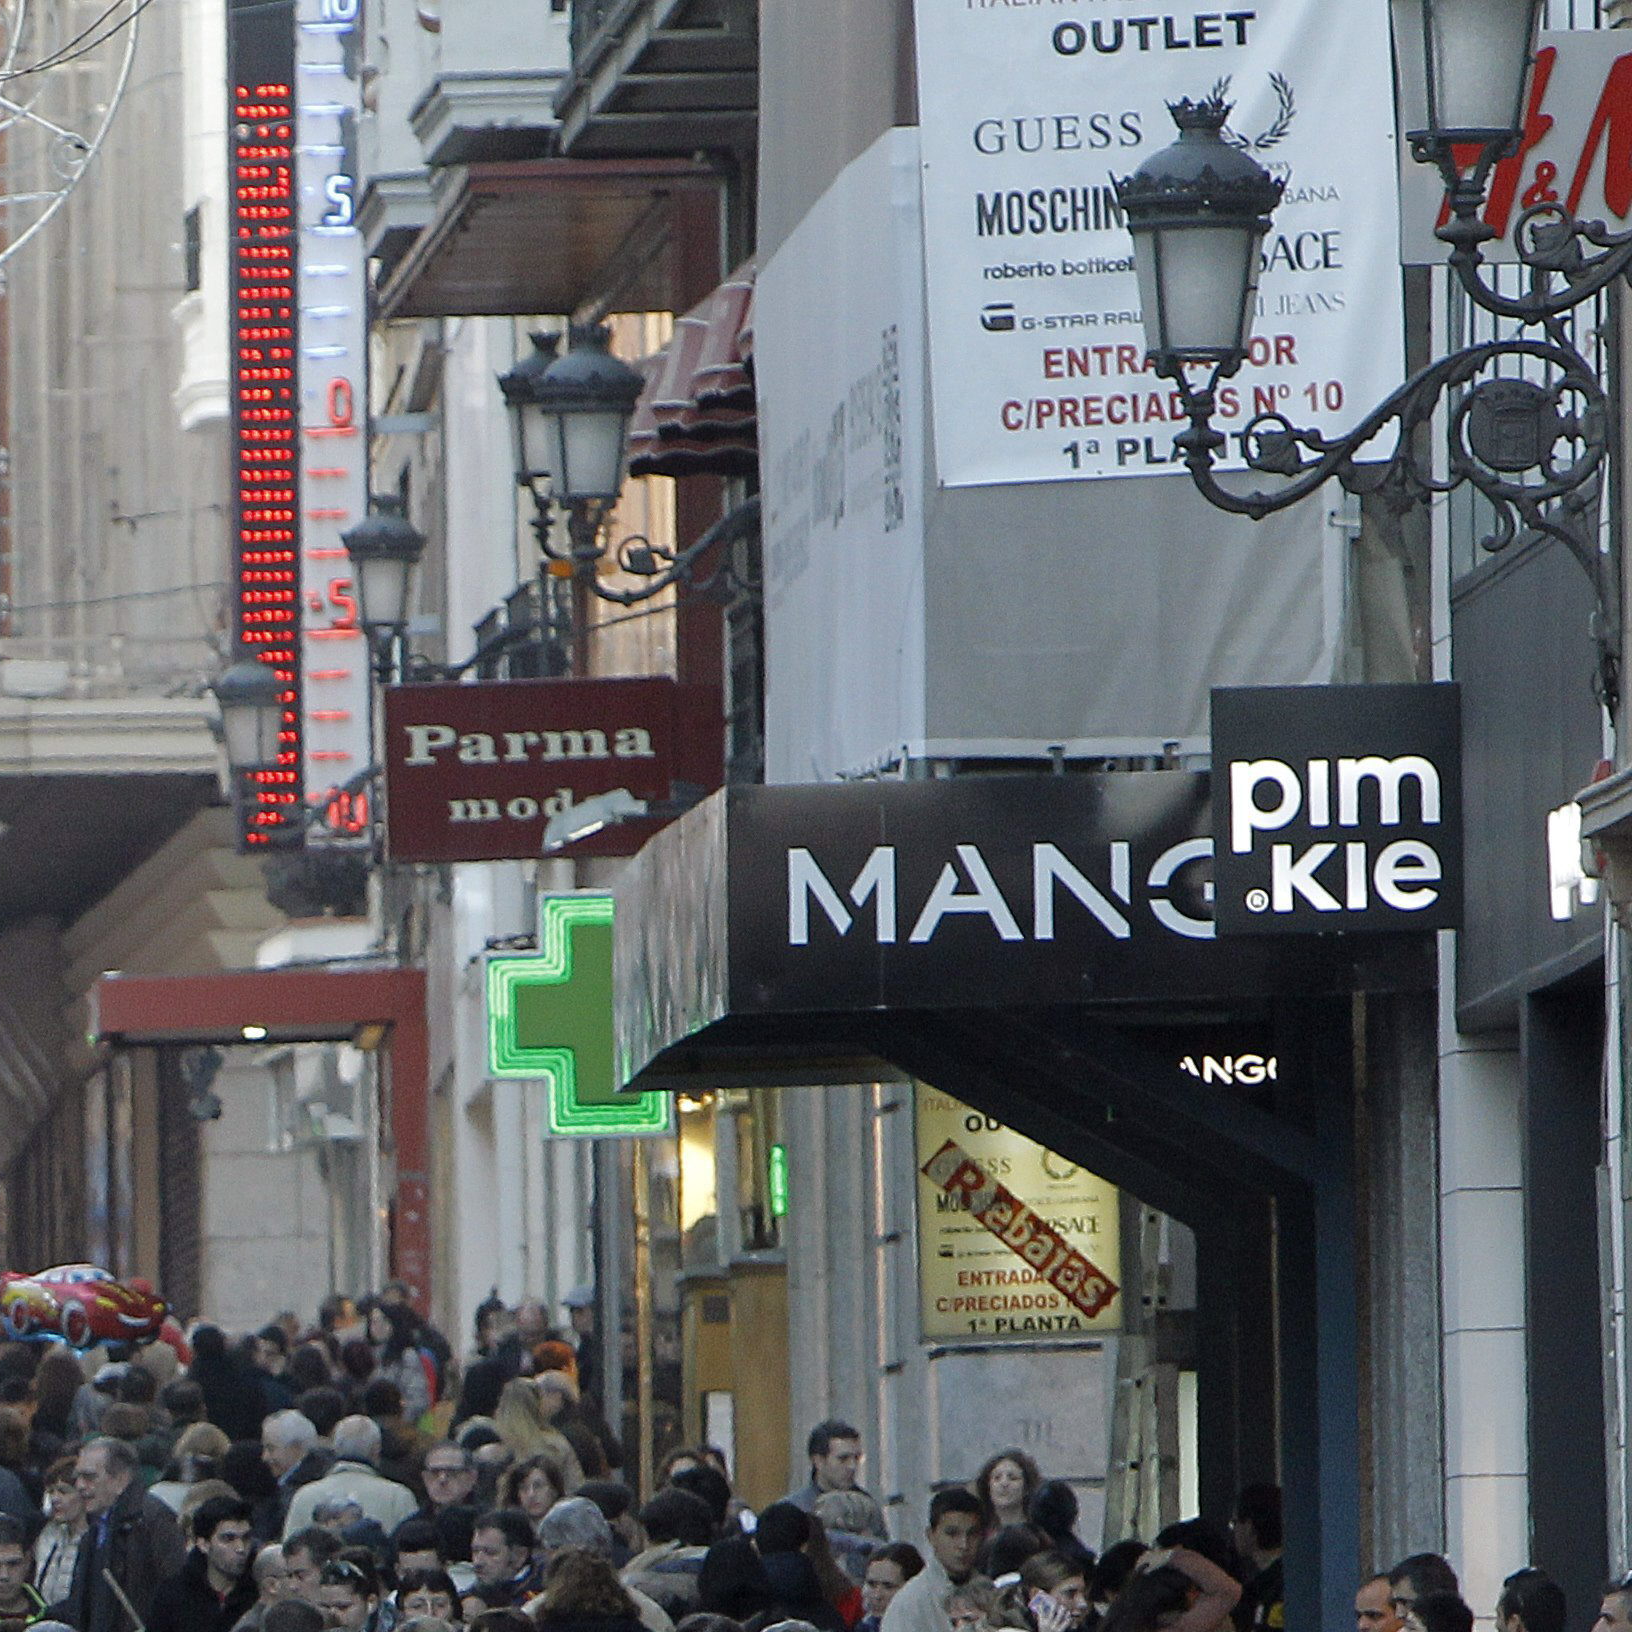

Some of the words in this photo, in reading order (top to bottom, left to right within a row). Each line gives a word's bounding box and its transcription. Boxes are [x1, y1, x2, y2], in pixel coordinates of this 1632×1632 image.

[1053, 11, 1257, 55] OUTLET
[974, 113, 1144, 154] GUESS
[326, 176, 353, 226] 5
[976, 186, 1127, 237] MOSCHIN
[983, 260, 1056, 281] roberto
[1021, 314, 1098, 331] G-STAR
[1247, 335, 1299, 367] OR
[1000, 387, 1239, 431] C/PRECIADS
[1303, 381, 1345, 413] 10
[403, 723, 657, 768] Parma
[448, 787, 574, 822] mod
[1229, 756, 1441, 854] pim
[787, 836, 1216, 946] MANG
[943, 1158, 1110, 1308] Rebajas
[995, 1314, 1082, 1333] PLANTA
